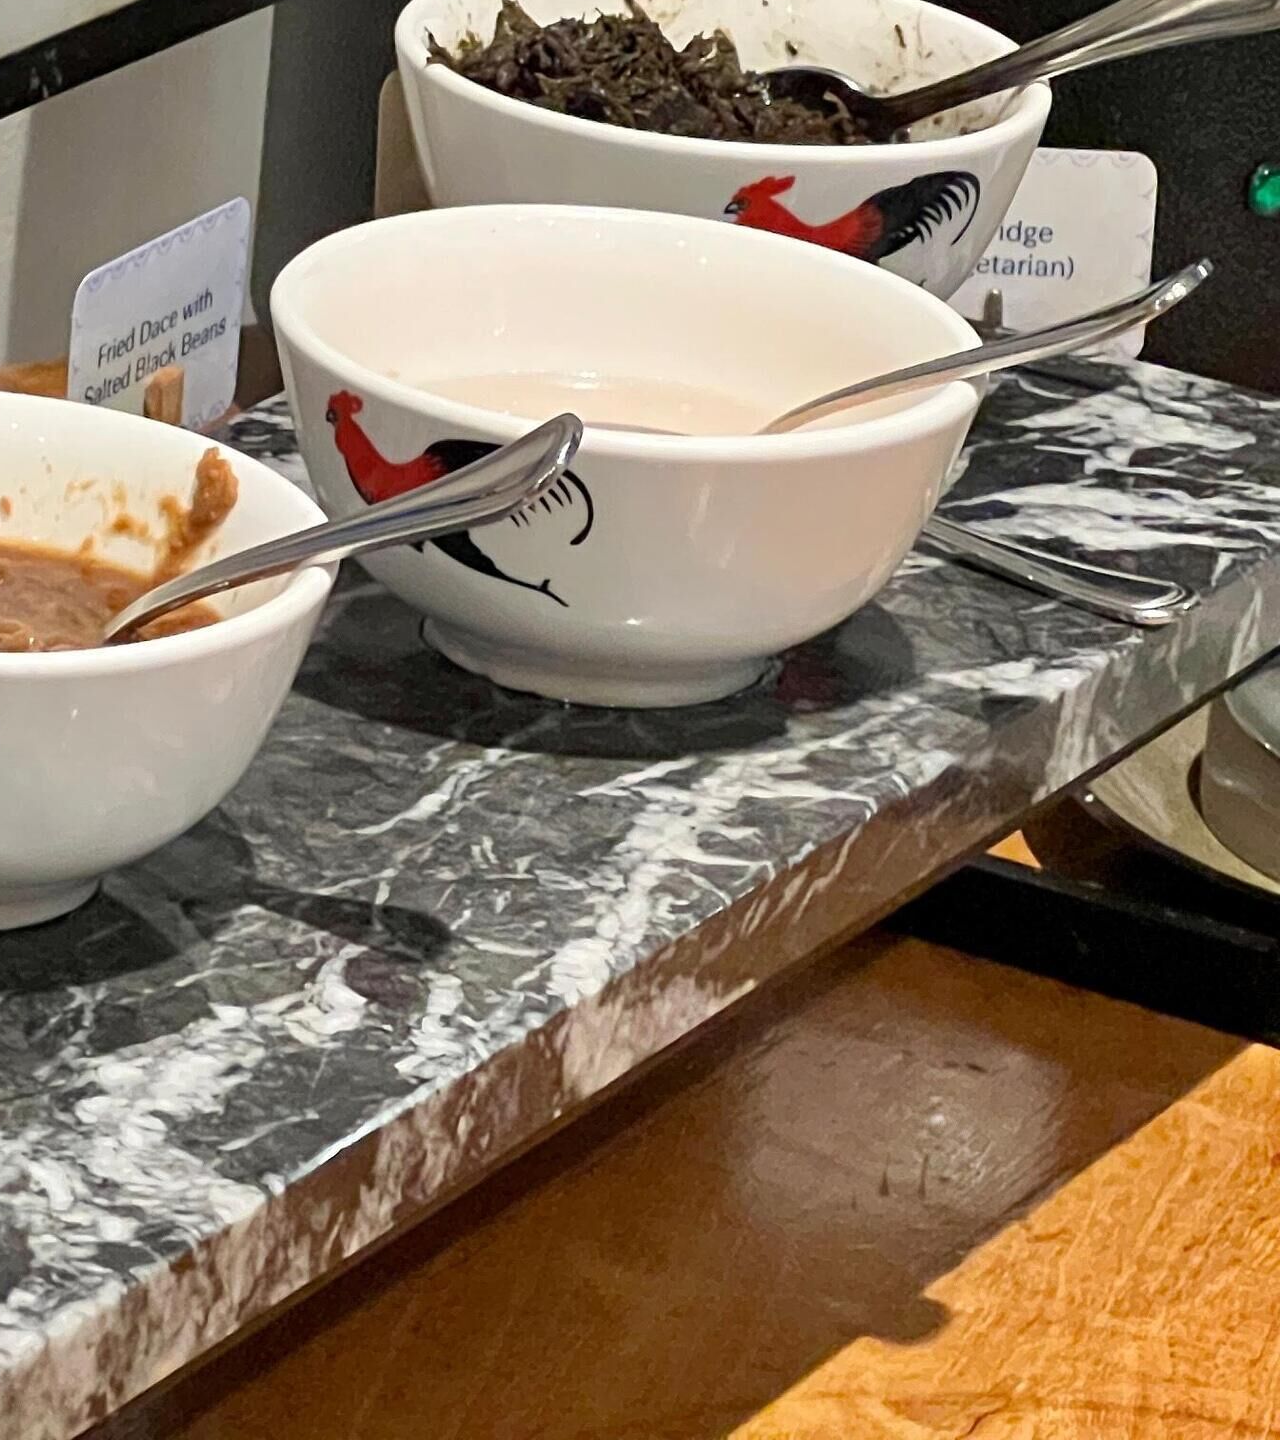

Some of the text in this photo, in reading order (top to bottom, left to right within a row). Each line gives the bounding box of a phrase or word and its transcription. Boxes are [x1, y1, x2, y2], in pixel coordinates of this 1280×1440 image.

[967, 253, 1074, 281] etarian)
[85, 316, 227, 404] Salted Black Beans
[98, 288, 213, 368] Fried Dace with
